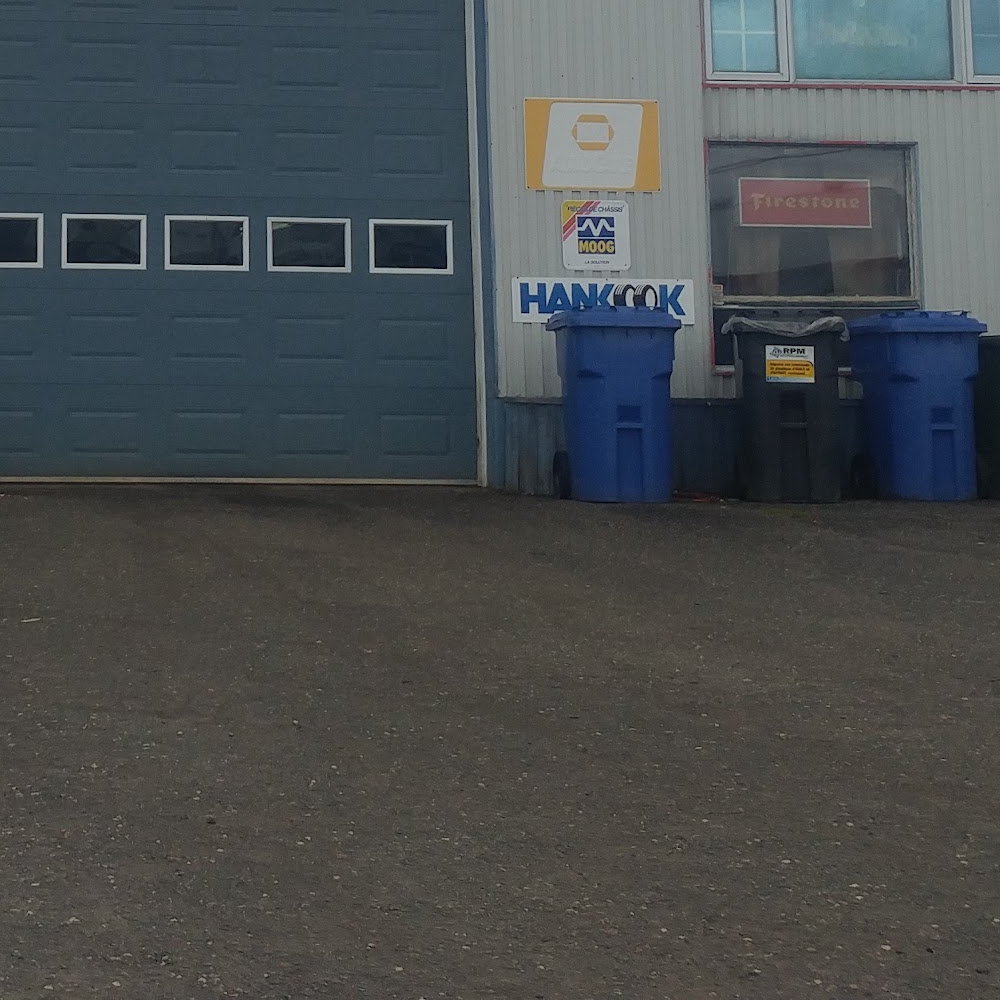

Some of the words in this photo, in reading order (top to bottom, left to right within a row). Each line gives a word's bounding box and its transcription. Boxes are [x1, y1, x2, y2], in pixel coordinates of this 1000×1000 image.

[751, 192, 860, 211] Firestone
[578, 240, 615, 253] MOOG
[783, 347, 806, 355] RPM
